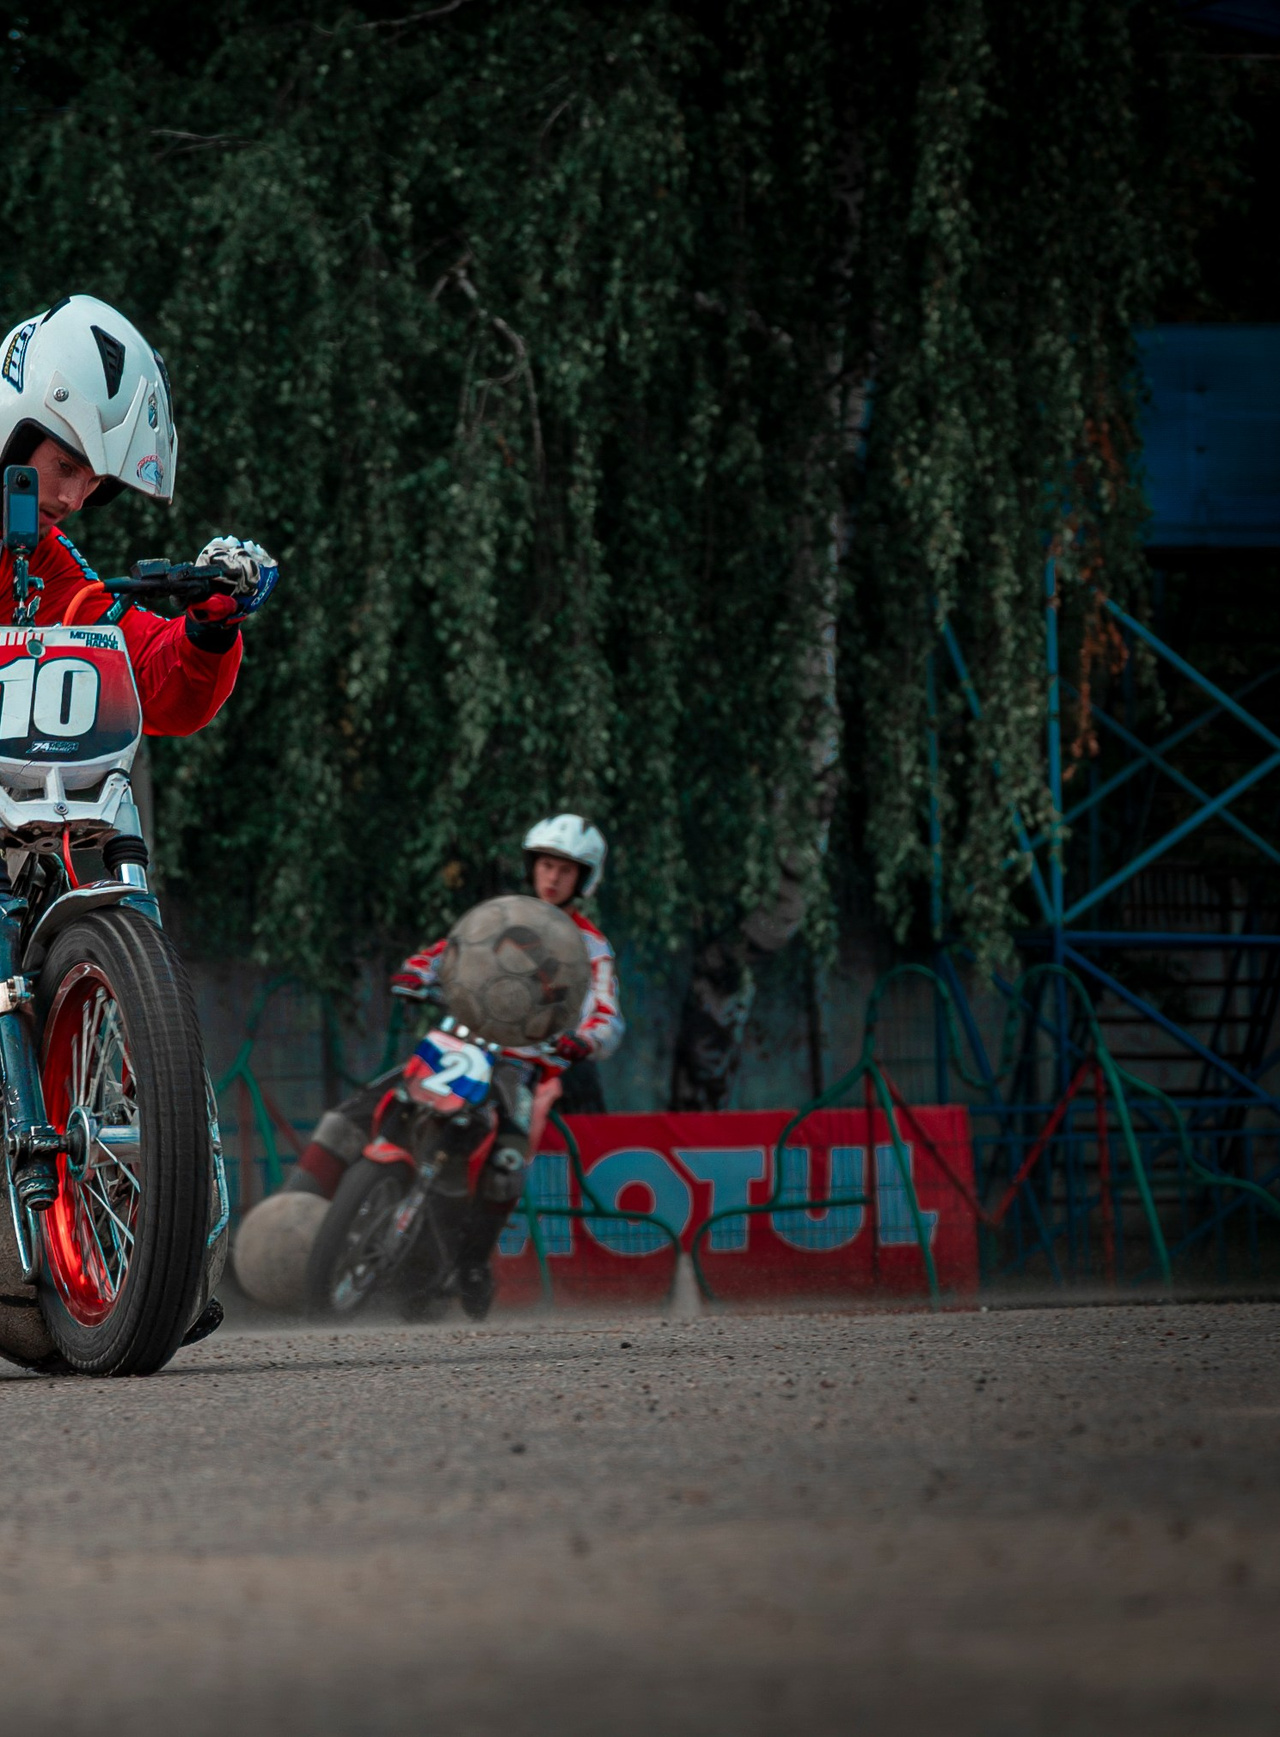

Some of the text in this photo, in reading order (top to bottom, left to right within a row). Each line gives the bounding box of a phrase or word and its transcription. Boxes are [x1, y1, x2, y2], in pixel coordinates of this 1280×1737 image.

[70, 630, 116, 641] MOTOBALL
[86, 639, 118, 650] RACING
[421, 1051, 471, 1097] 2
[498, 1144, 938, 1256] MOTUL
